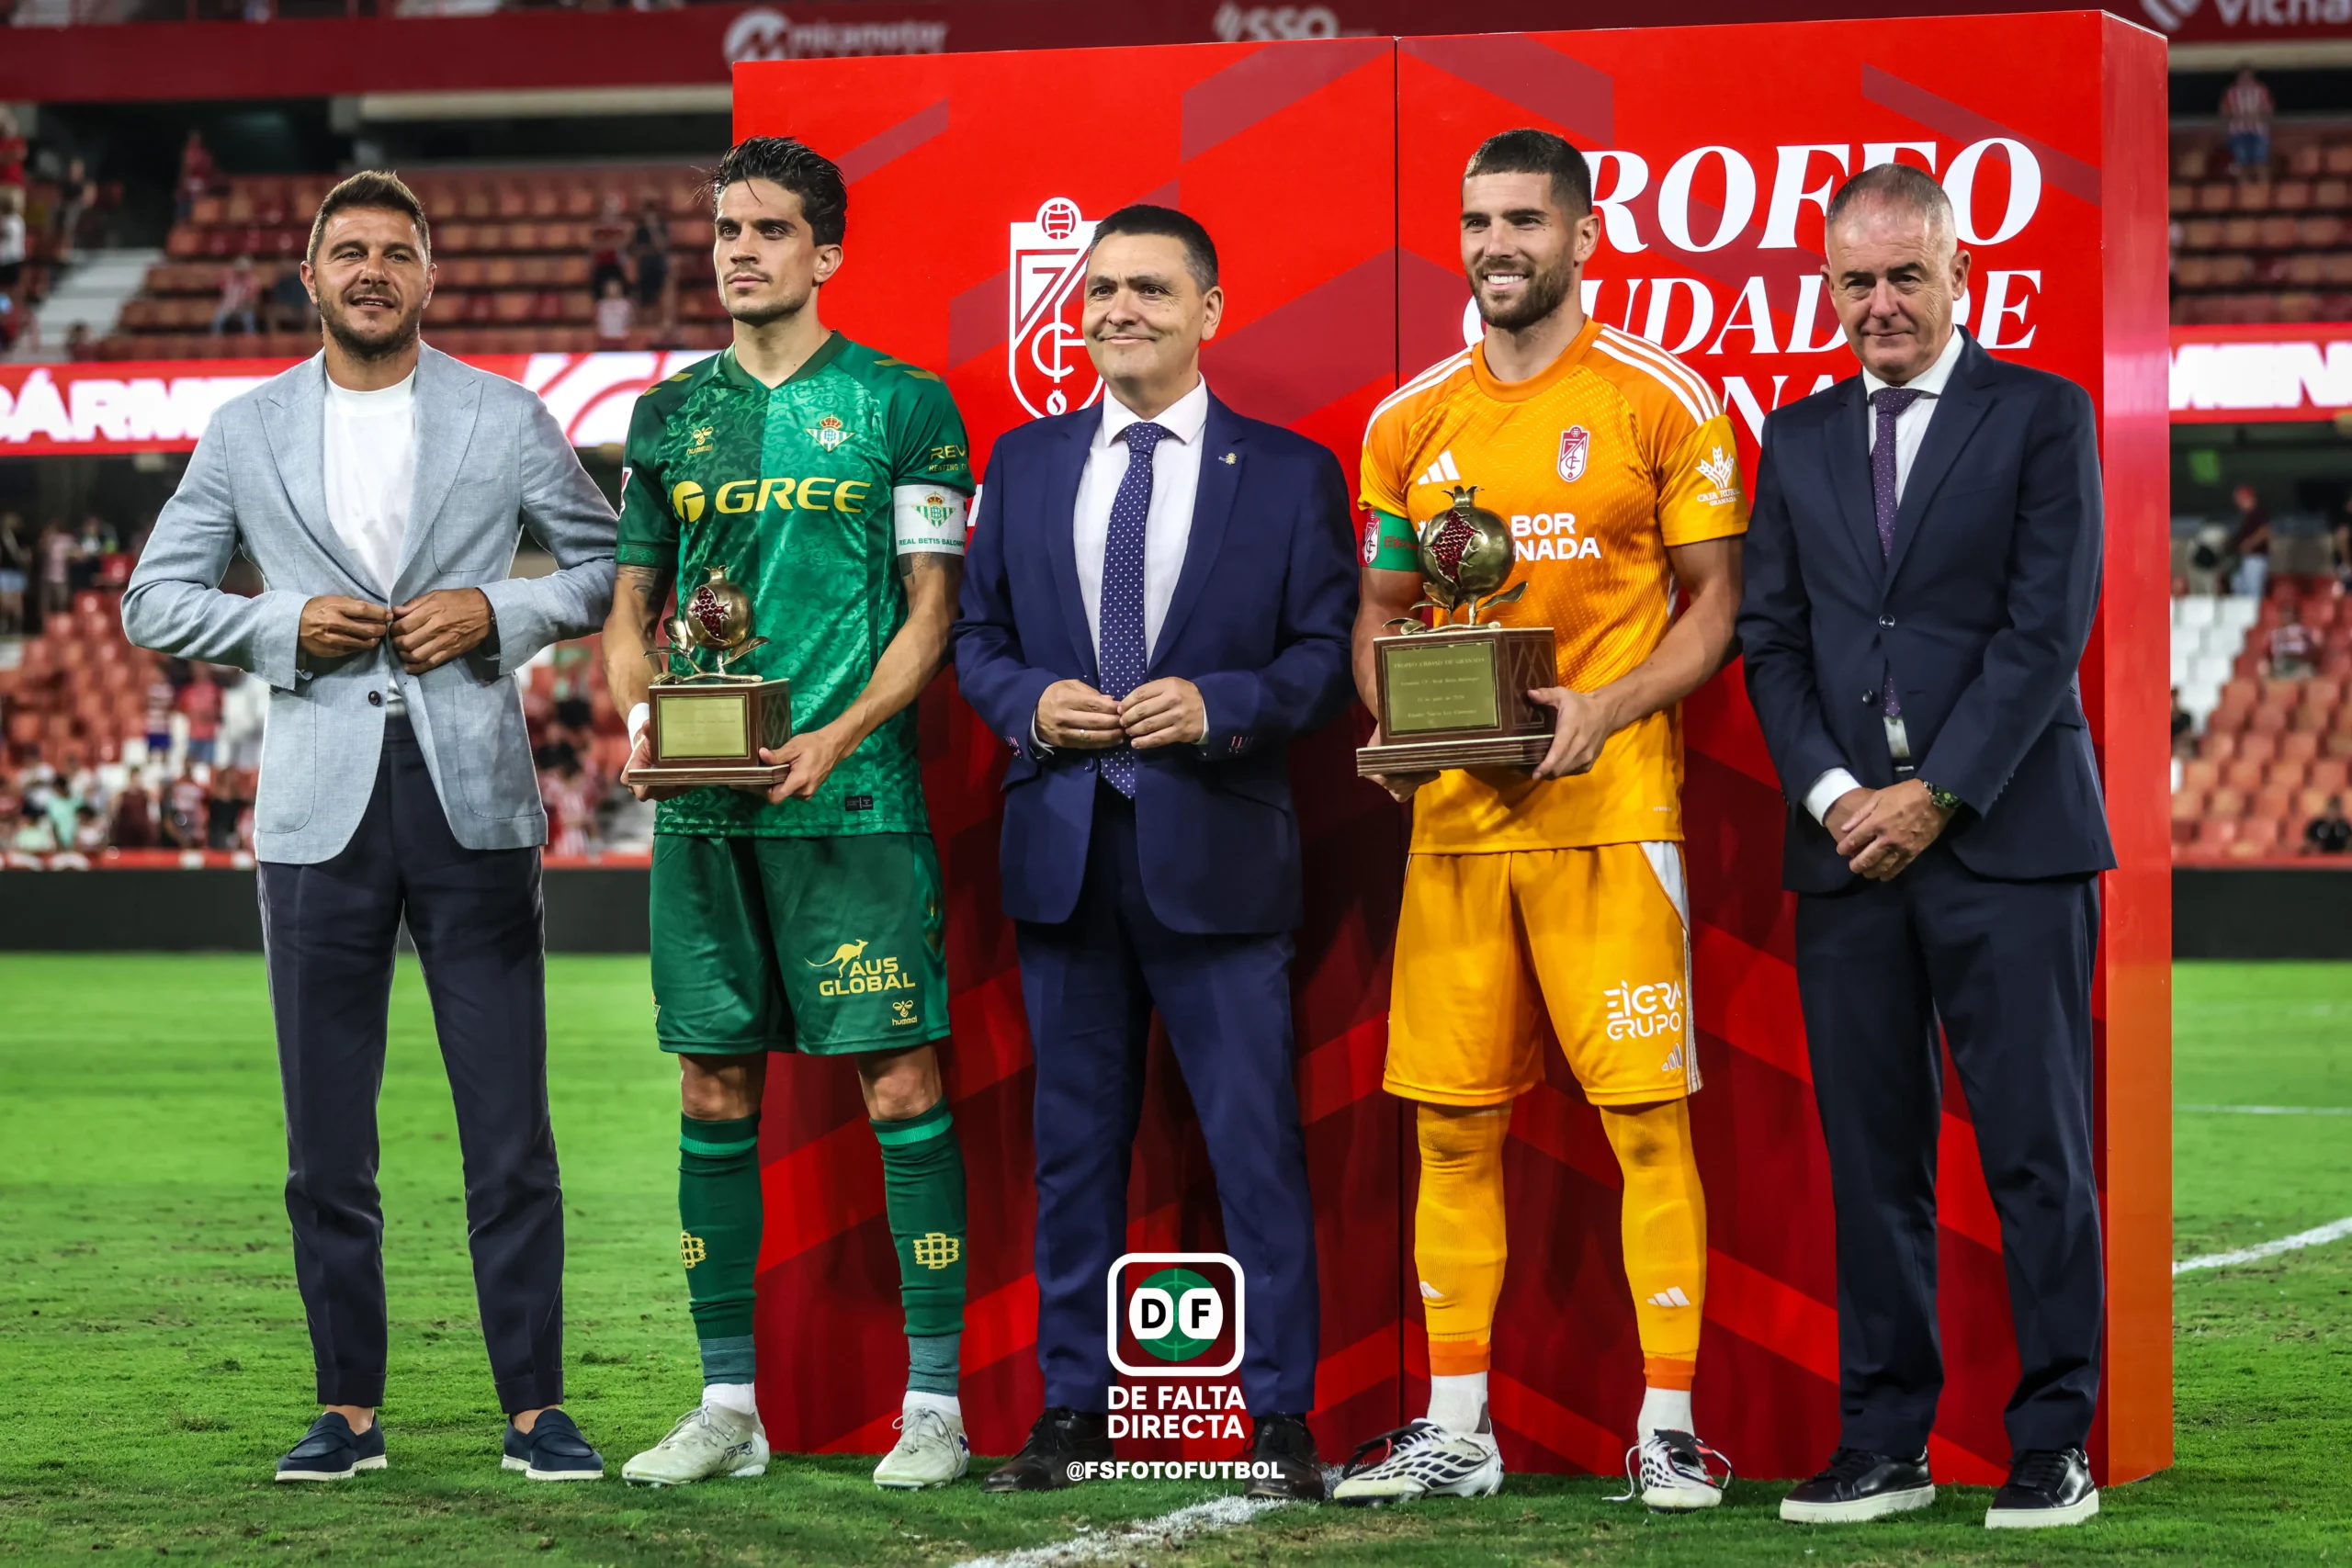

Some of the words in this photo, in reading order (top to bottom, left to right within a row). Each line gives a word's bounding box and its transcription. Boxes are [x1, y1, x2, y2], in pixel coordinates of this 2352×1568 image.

[1582, 137, 2041, 253] ROFO
[715, 477, 871, 514] GREE
[1697, 491, 1719, 502] CAJA
[1709, 496, 1736, 506] GRANADA
[849, 957, 899, 978] AUS
[820, 973, 916, 997] GLOBAL
[892, 1015, 918, 1026] hummel
[1606, 1011, 1681, 1040] GRUPO
